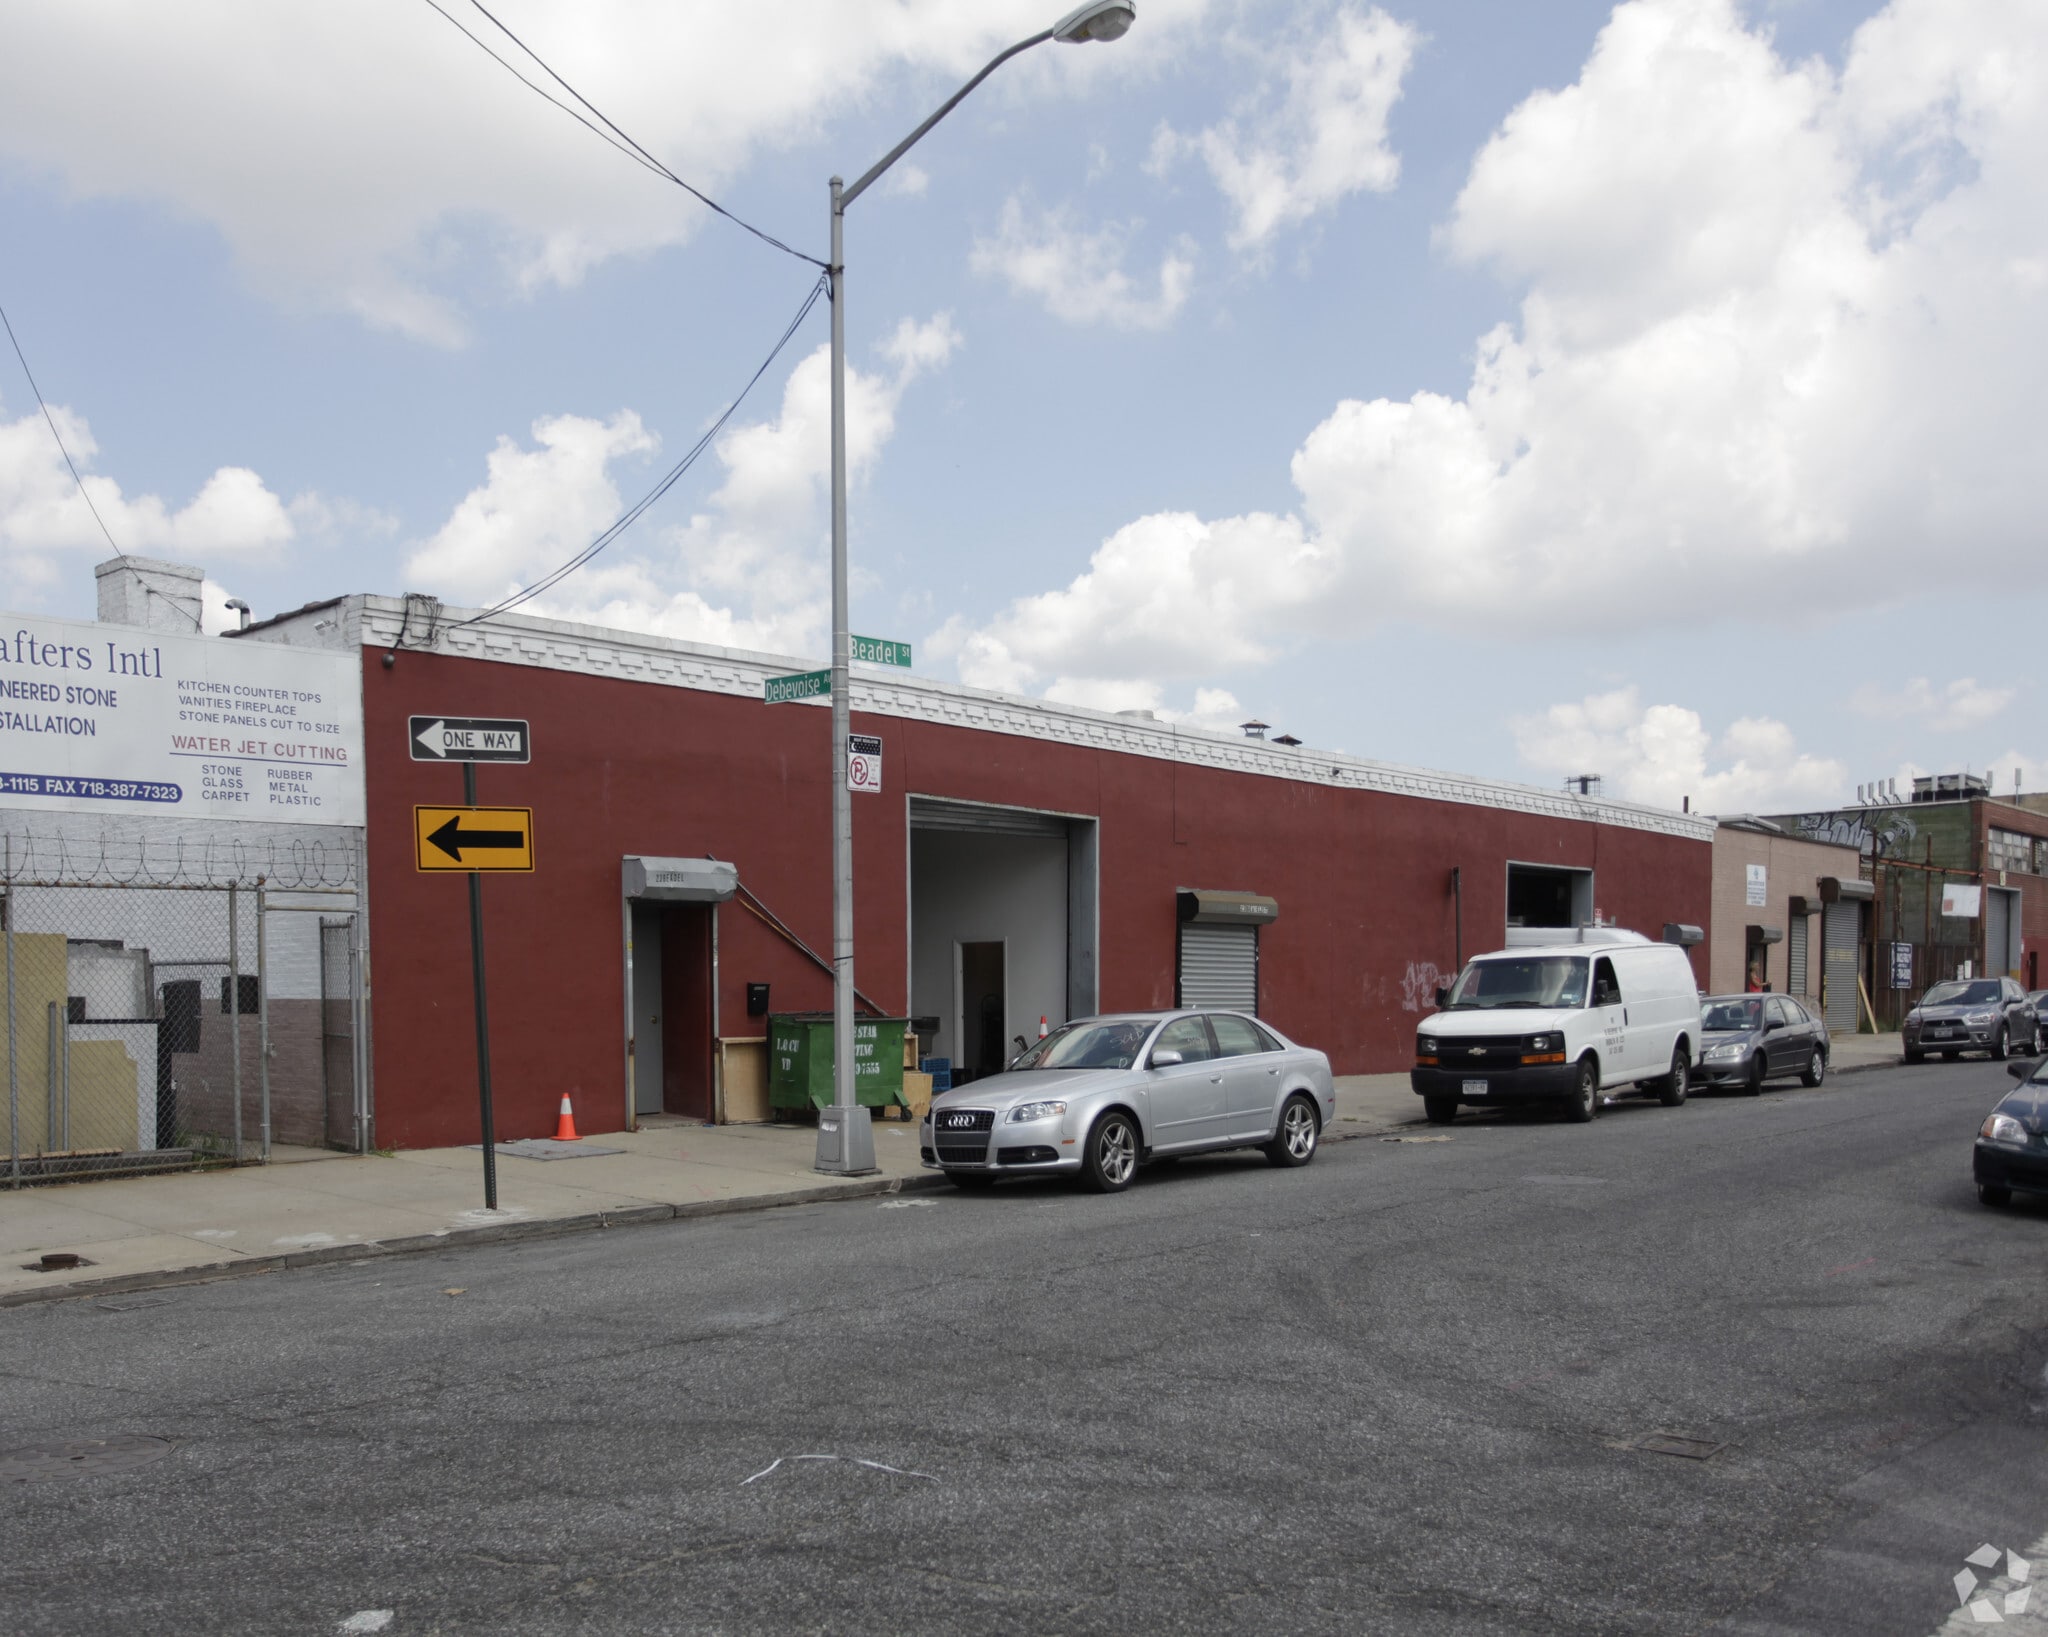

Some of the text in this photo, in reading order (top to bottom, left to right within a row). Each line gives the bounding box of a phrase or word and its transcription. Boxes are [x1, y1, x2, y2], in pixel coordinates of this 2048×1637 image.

[0, 630, 163, 678] afters Intl
[849, 637, 897, 664] Beadel
[0, 680, 117, 707] NEERED STONE
[177, 680, 322, 704] KITCHEN COUNTER TOPS
[766, 675, 820, 701] Debevoise
[178, 695, 296, 716] VANITIES FIREPLACE
[179, 710, 340, 734] STONE PANELS CUT TO SIZE
[172, 735, 347, 761] WATER JET CUTTING
[443, 731, 516, 749] ONE WAY
[202, 764, 242, 776] STONE
[267, 769, 313, 781] RUBBER
[46, 779, 76, 794] FAX
[79, 781, 178, 800] 718-387-7323
[202, 777, 243, 789] GLASS
[269, 782, 308, 793] METAL
[202, 790, 250, 802] CARPET
[270, 794, 321, 806] PLASTIC
